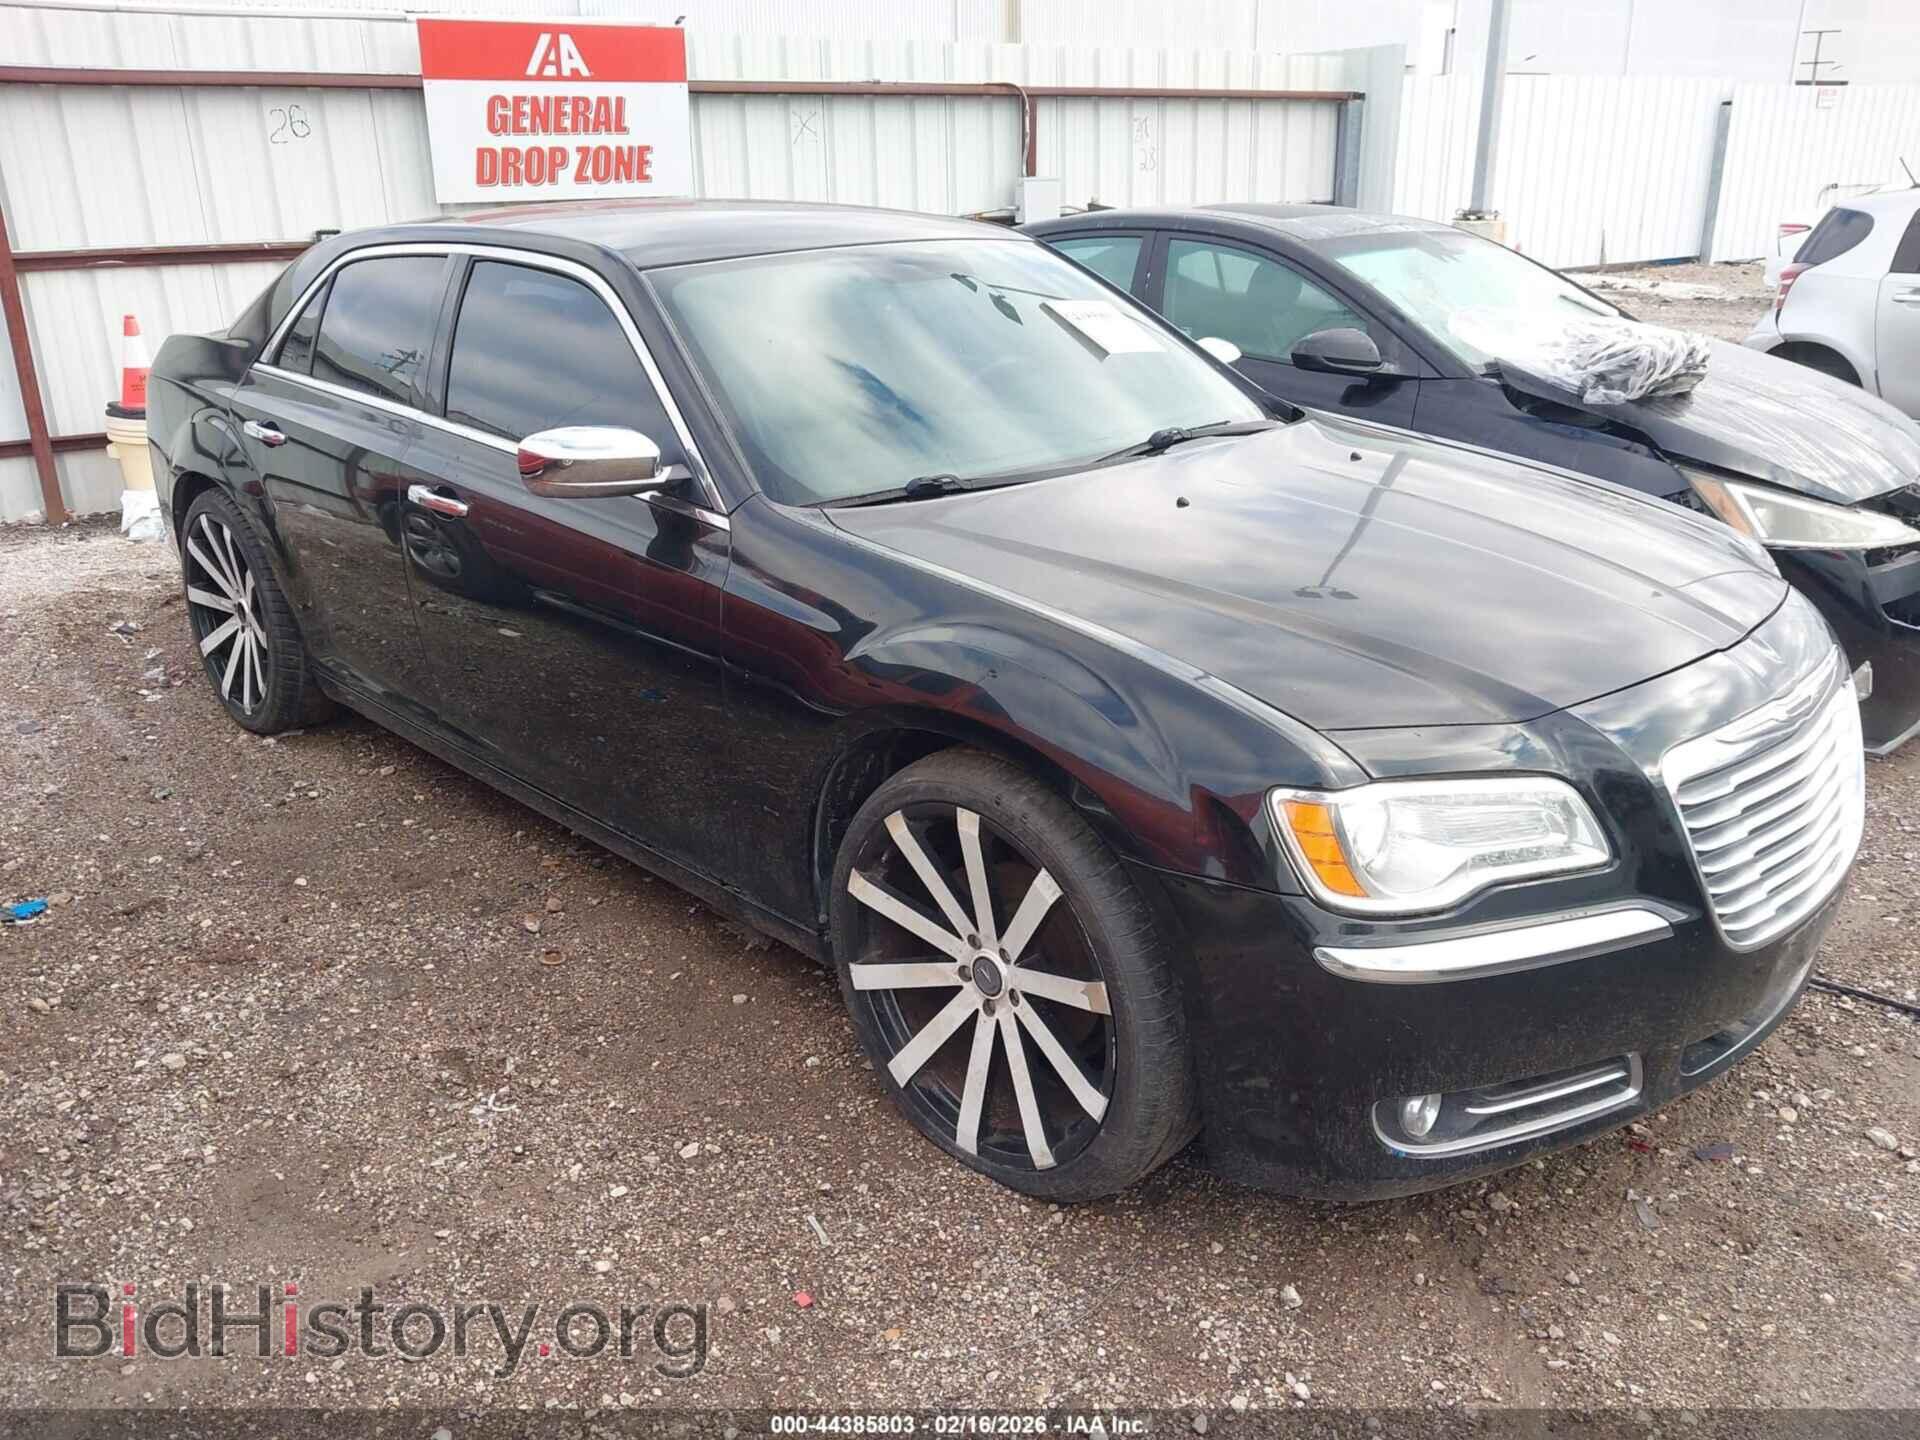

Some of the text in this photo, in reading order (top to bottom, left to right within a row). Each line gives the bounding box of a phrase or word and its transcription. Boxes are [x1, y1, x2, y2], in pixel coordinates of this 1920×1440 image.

[270, 104, 311, 144] 26
[486, 94, 630, 136] GENERAL
[475, 145, 653, 187] DROP ZONE
